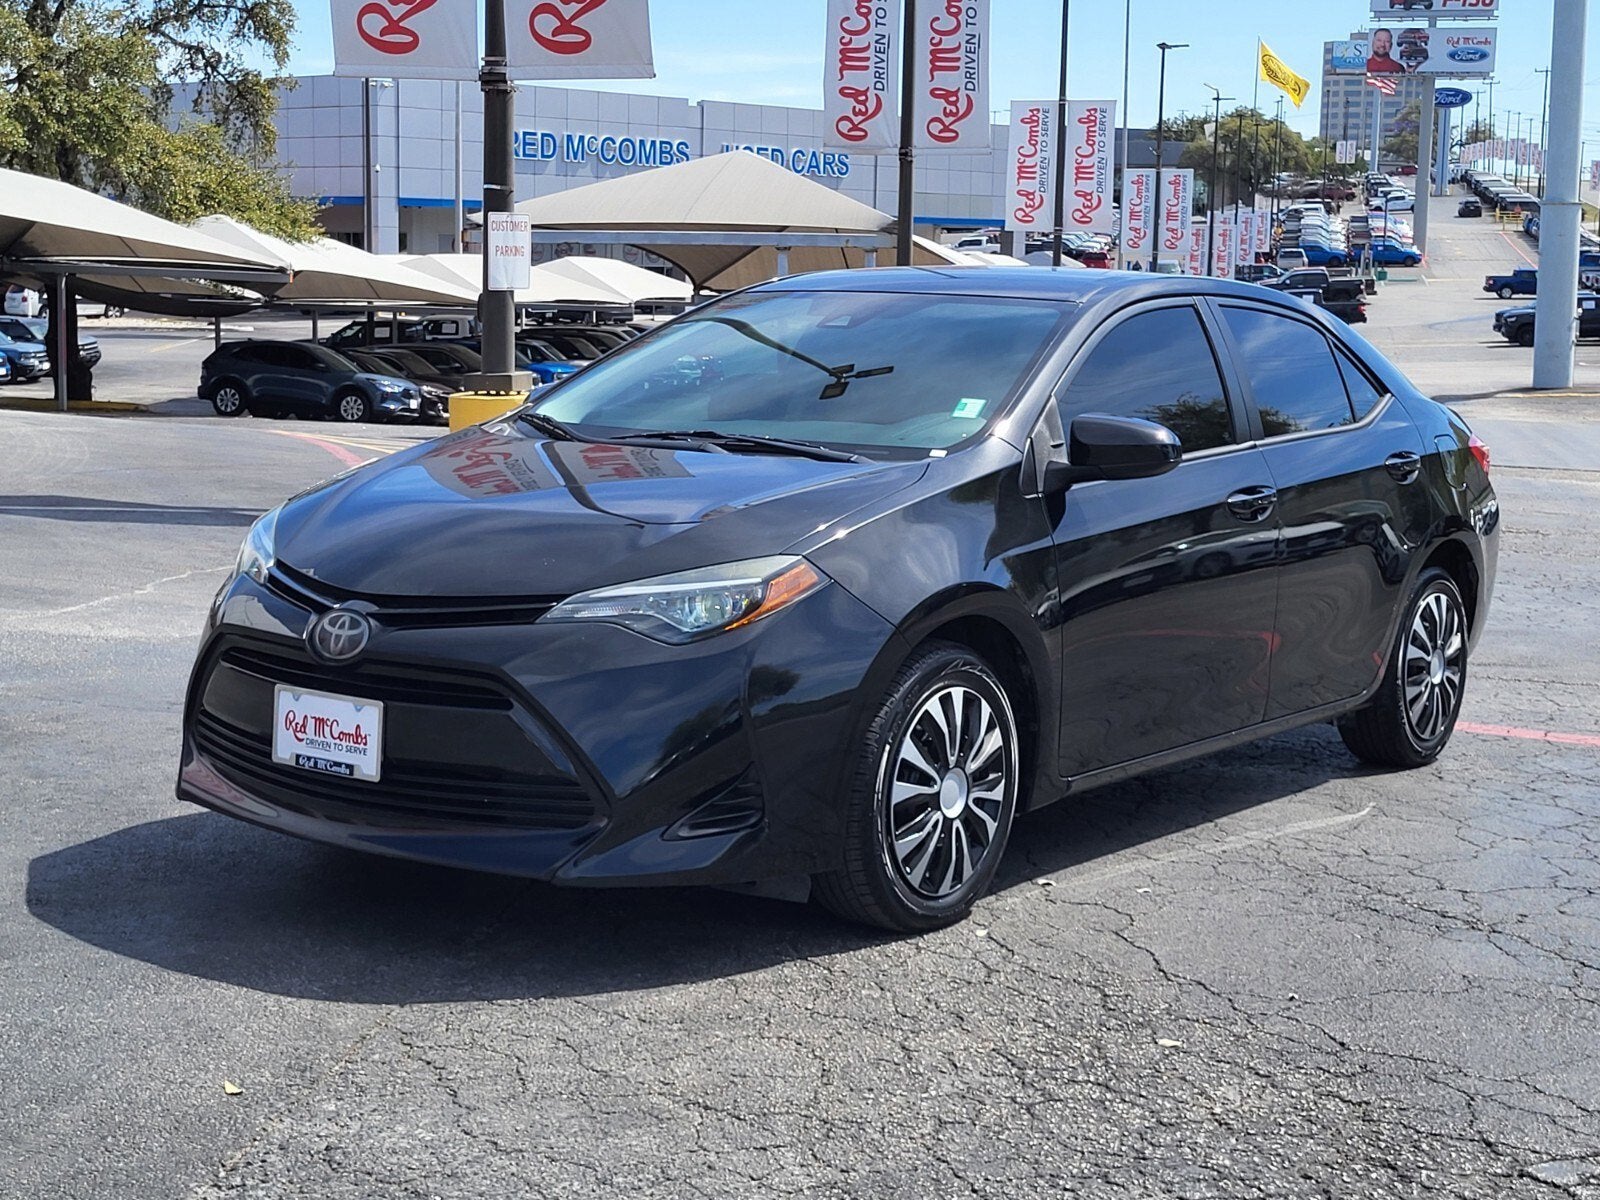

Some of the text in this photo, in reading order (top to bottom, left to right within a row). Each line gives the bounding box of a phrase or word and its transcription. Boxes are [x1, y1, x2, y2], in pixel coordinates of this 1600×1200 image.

[875, 7, 887, 28] TO
[966, 7, 977, 28] TO
[836, 0, 882, 142] Red McCo
[874, 33, 887, 91] DRIVEN
[926, 0, 973, 143] Red McCo
[965, 33, 977, 92] DRIVEN
[1455, 50, 1480, 60] Ford
[1434, 91, 1463, 104] Ford
[791, 149, 850, 177] CARS
[1014, 108, 1044, 224] Red McCombs
[1039, 107, 1050, 193] DRIVEN TO SERVE
[1072, 108, 1102, 225] Red McCombs
[1096, 107, 1107, 193] DRIVEN TO SERVE
[491, 220, 528, 232] CUSTOMER
[1127, 174, 1147, 249] Red McCombs
[1164, 174, 1184, 250] Red McCombs
[495, 245, 525, 257] PARKING
[285, 710, 368, 746] Red McCombs
[305, 737, 368, 756] DRIVEN TO SERVE
